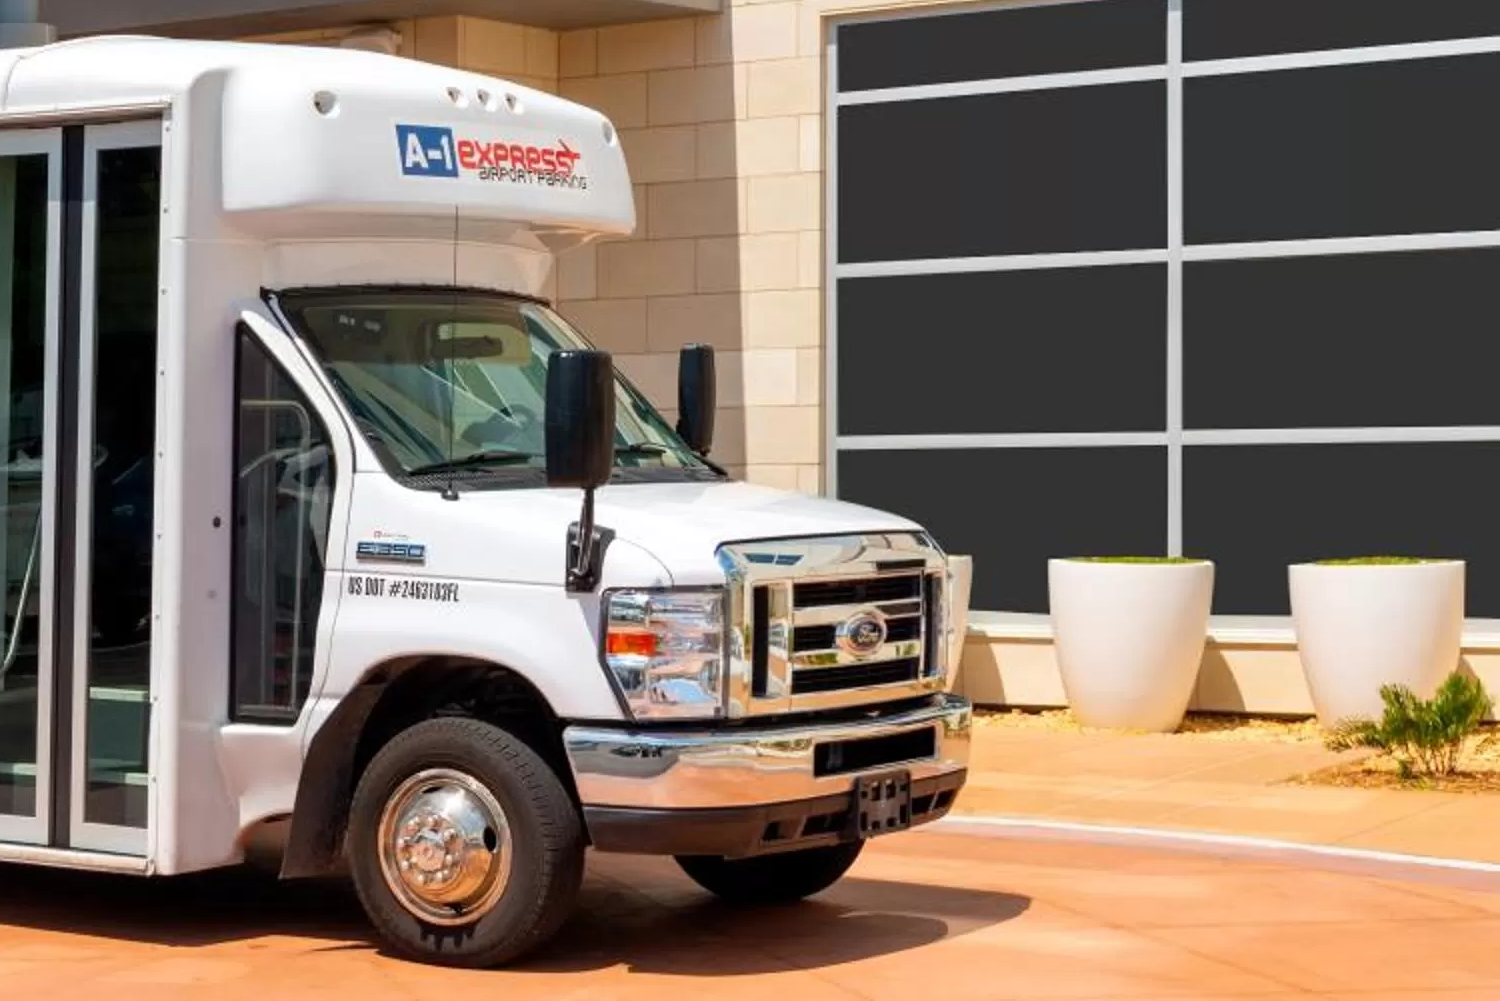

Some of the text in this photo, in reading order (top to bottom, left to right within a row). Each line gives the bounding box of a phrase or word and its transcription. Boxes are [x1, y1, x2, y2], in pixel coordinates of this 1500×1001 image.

[405, 132, 453, 170] A-1
[348, 576, 362, 595] US
[366, 577, 385, 596] DOT
